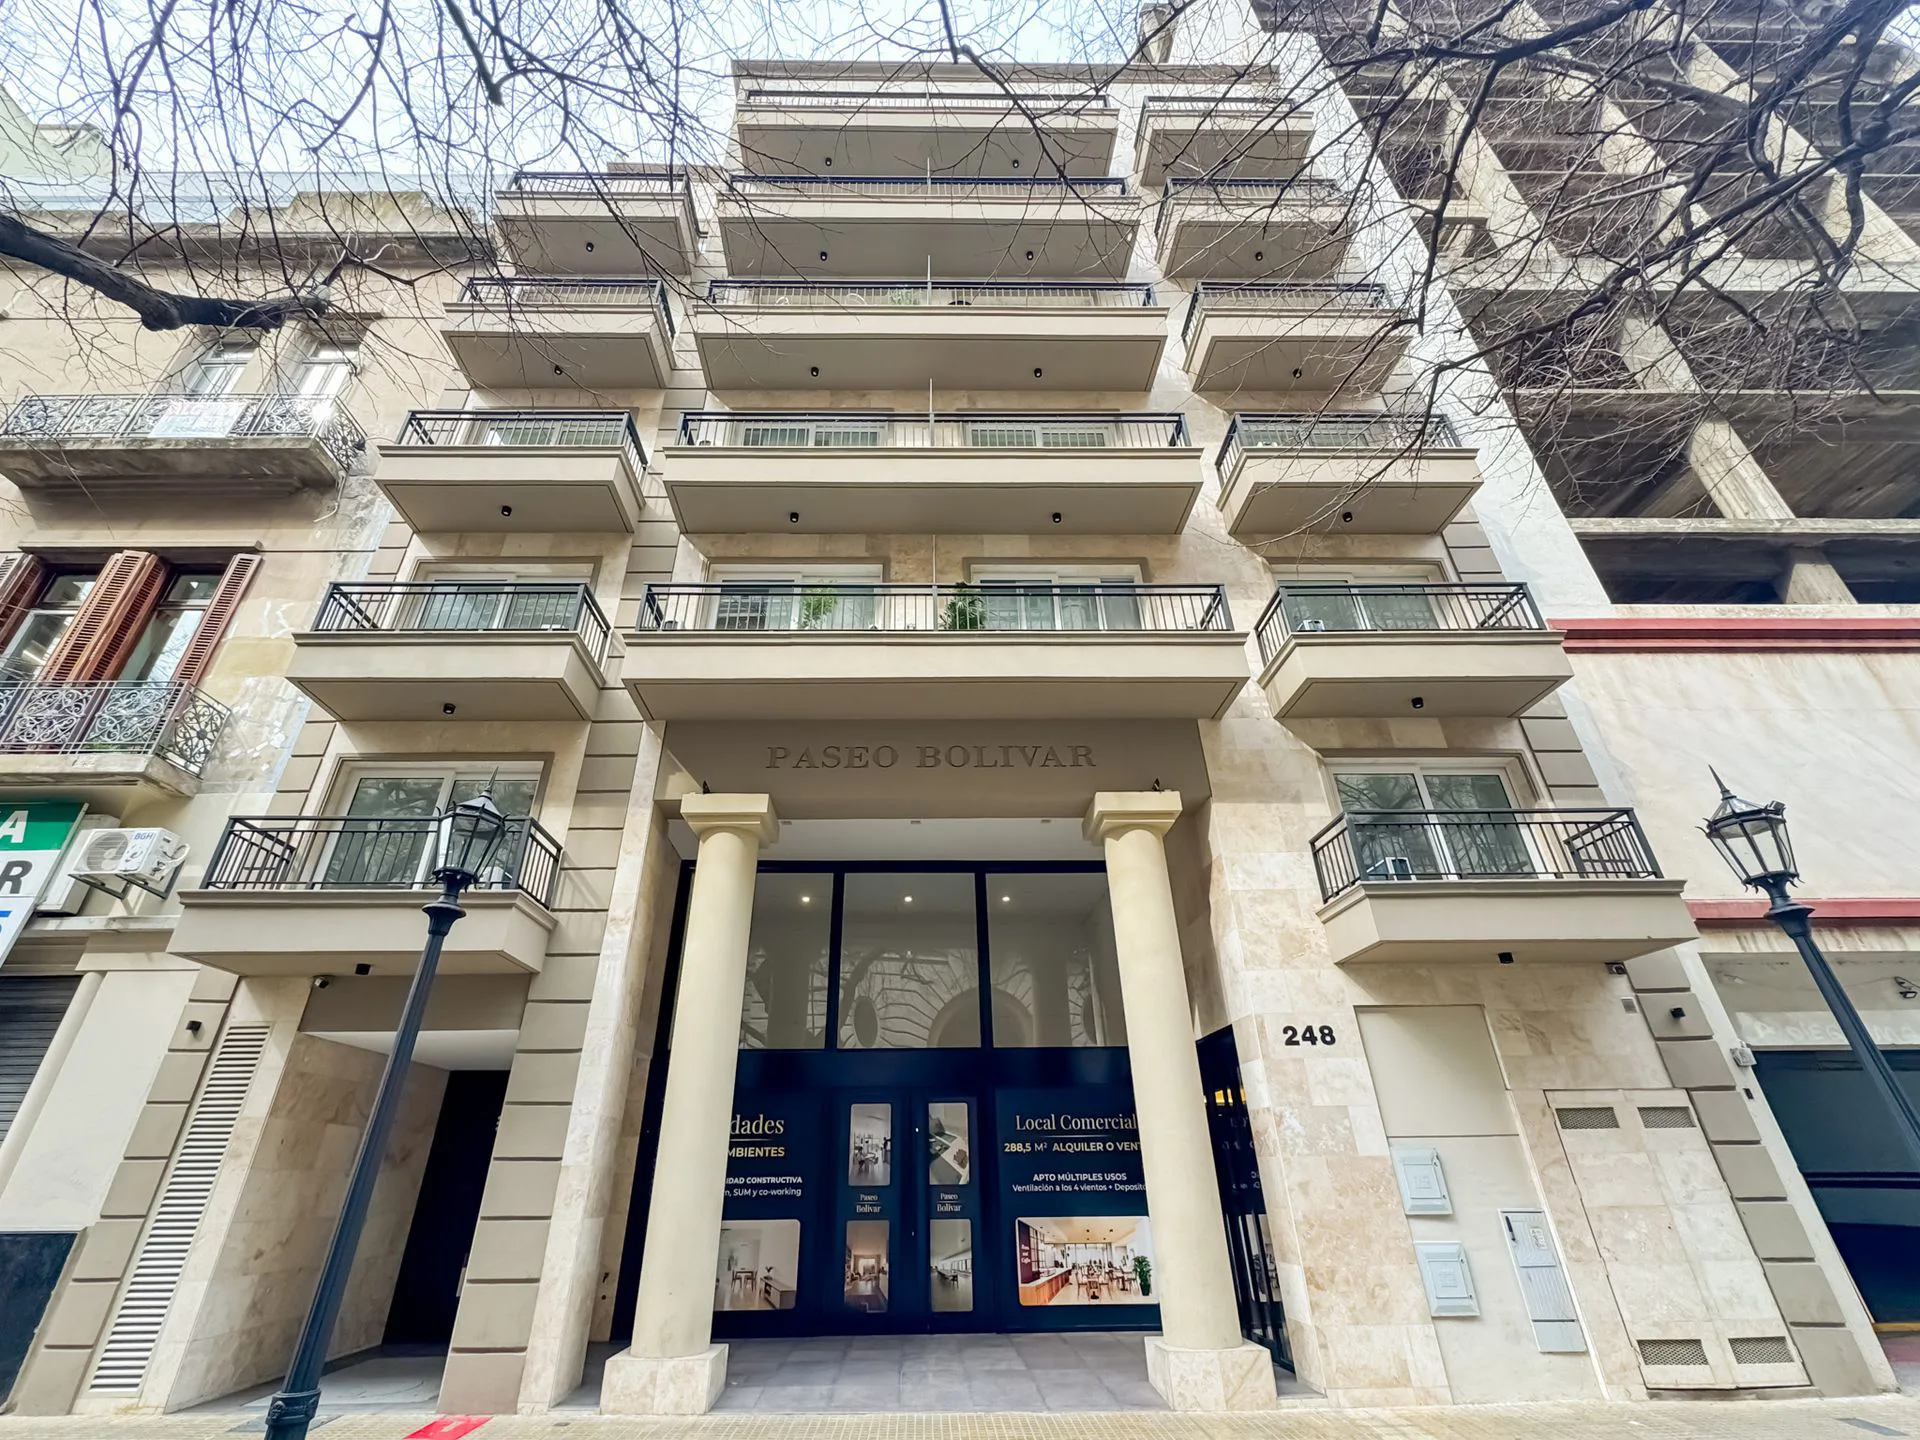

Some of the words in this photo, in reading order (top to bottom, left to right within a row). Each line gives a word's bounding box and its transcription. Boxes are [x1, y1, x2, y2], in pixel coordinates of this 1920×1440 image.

[766, 745, 899, 769] PASEO
[916, 745, 1097, 768] BOLIVAR
[134, 832, 154, 840] BGH
[1282, 1025, 1336, 1046] 248
[730, 1113, 785, 1135] dades
[1016, 1113, 1056, 1131] Local
[1060, 1113, 1137, 1131] Comercial
[728, 1146, 785, 1158] MBIENTES
[1004, 1143, 1032, 1154] 288,5
[1052, 1142, 1104, 1154] ALQUILER
[1105, 1143, 1115, 1152] O
[746, 1176, 803, 1184] CONSTRUCTIVA
[1033, 1173, 1056, 1182] APTO
[1057, 1171, 1103, 1181] MÚLTIPLES
[1104, 1172, 1127, 1181] USOS
[733, 1188, 751, 1196] SUM
[752, 1190, 758, 1198] y
[758, 1187, 802, 1197] co-working
[1012, 1183, 1053, 1192] Ventilación
[1061, 1183, 1072, 1191] los
[1080, 1183, 1107, 1191] vientos
[860, 1193, 878, 1201] Paseo
[940, 1192, 959, 1200] Paseo
